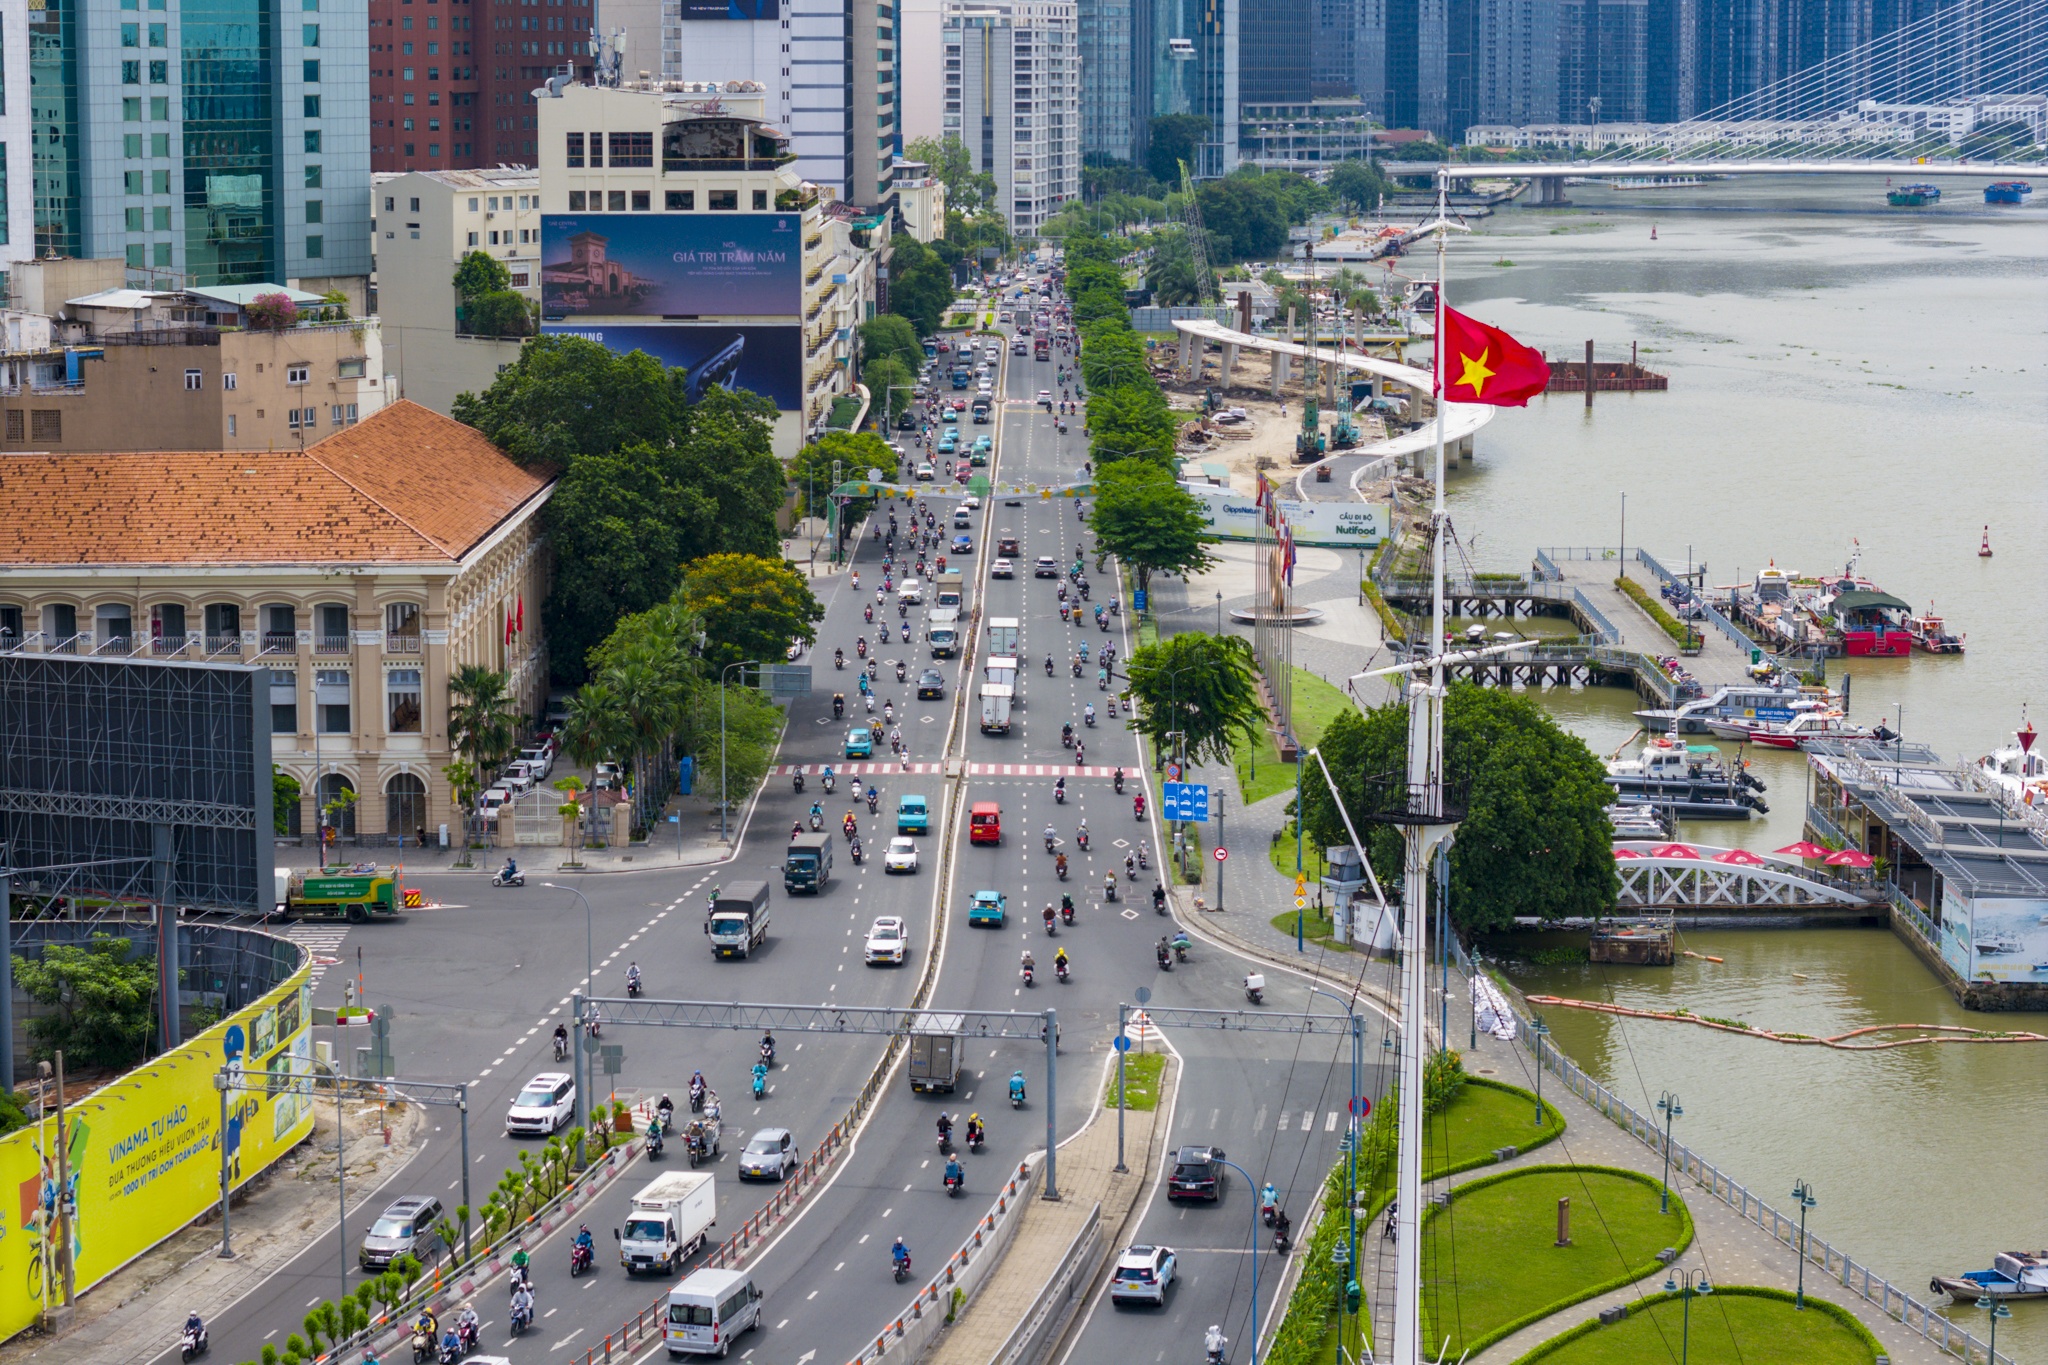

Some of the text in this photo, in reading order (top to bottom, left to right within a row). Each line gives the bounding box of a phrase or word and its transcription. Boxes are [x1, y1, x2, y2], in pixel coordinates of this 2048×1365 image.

[673, 249, 786, 266] GIÁ TRỊ TRĂM NĂM
[1363, 513, 1373, 522] BỘ
[1336, 525, 1376, 535] Nutifood
[109, 1104, 188, 1164] VINAMA TỰ HÀO
[159, 1139, 175, 1158] HIỆU
[123, 1178, 139, 1197] 1000
[140, 1173, 147, 1188] VỊ
[148, 1164, 159, 1182] TRÍ
[159, 1157, 174, 1175] OOH
[175, 1146, 192, 1166] TOÀN
